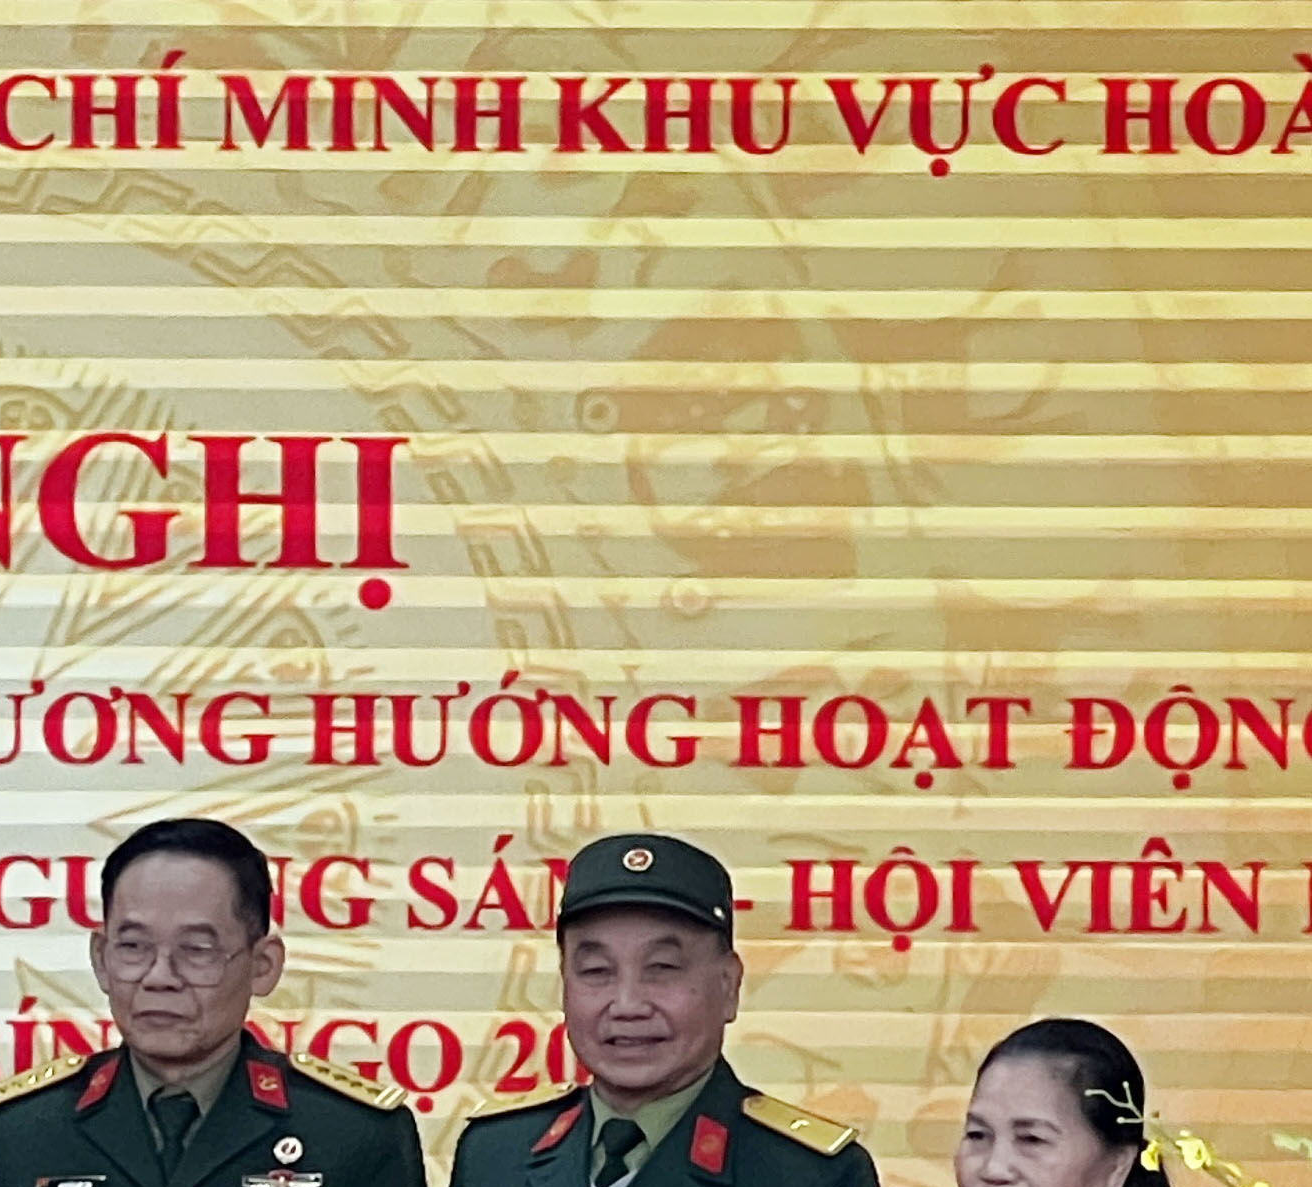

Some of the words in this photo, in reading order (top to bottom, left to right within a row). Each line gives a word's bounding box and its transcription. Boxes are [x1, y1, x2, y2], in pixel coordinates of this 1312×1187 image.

[219, 74, 525, 153] MINH
[556, 77, 797, 155] KHU
[826, 63, 1067, 178] VỰC
[307, 670, 702, 767] HƯỚNG
[731, 695, 1032, 789] HOẠT
[1065, 684, 1312, 790] ĐỘN
[784, 847, 978, 953] HỘI
[1009, 836, 1267, 934] VIÊN
